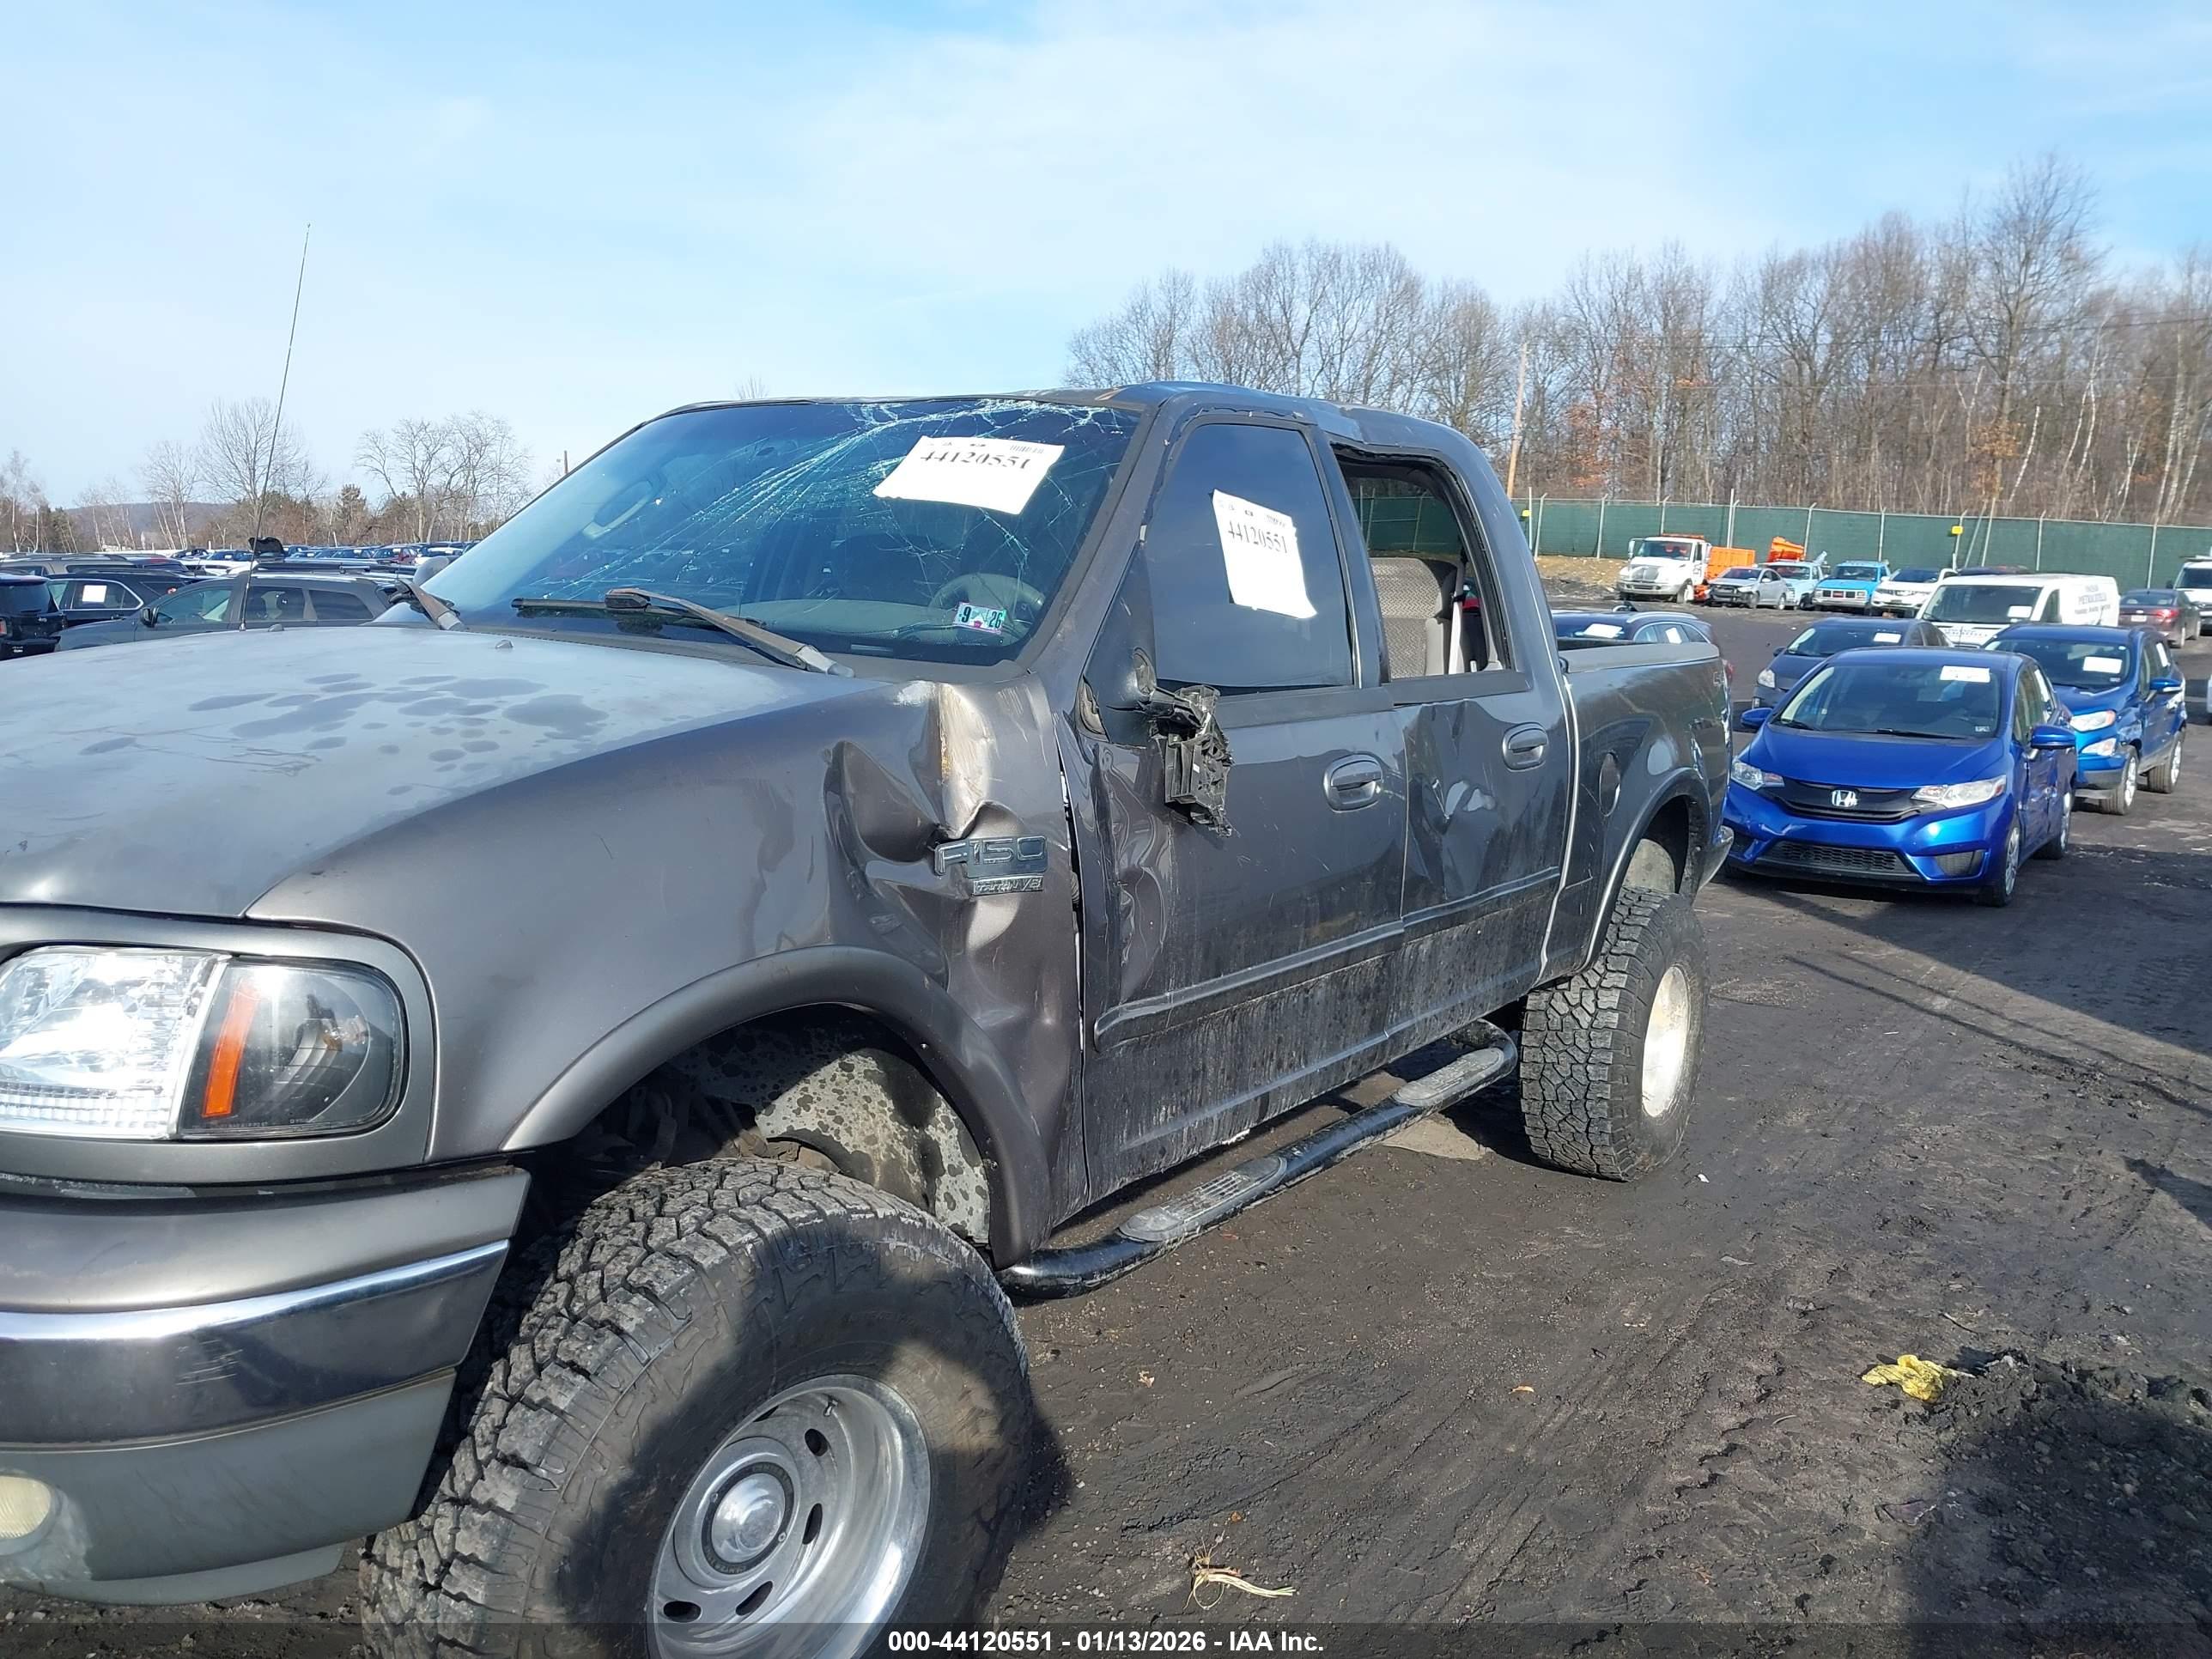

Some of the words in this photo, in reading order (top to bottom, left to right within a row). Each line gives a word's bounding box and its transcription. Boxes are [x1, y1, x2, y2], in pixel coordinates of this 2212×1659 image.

[920, 450, 1032, 471] 44120551
[1227, 520, 1289, 555] 44120551
[961, 606, 972, 623] 9
[988, 611, 1003, 629] 26
